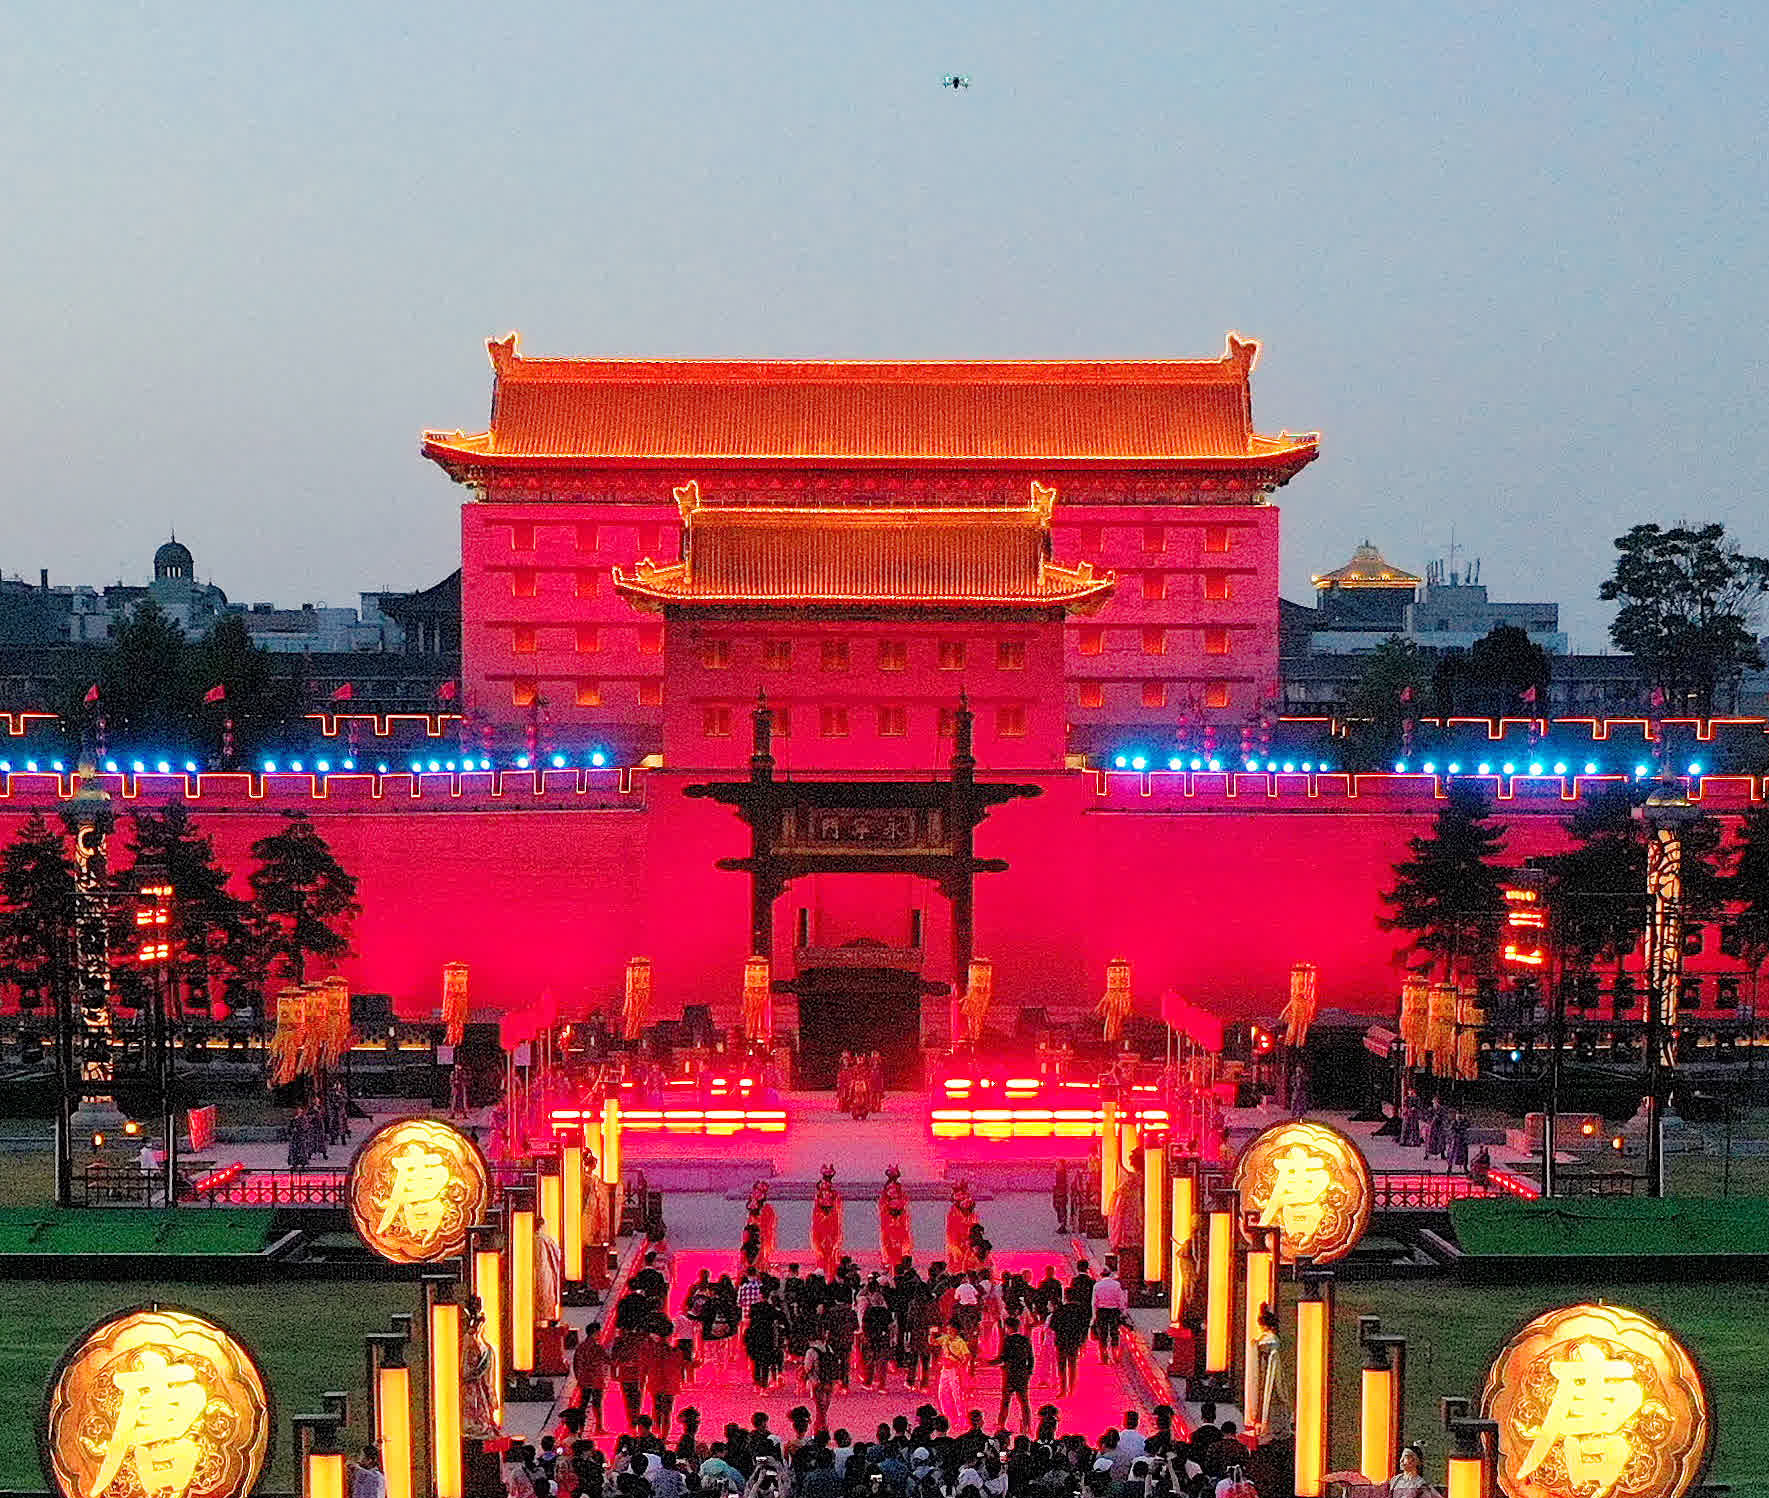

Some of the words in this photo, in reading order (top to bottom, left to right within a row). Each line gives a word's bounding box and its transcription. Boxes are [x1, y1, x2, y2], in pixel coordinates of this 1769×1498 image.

[376, 1144, 450, 1237] 唐
[1258, 1146, 1331, 1236] 唐
[90, 1350, 207, 1498] 唐
[1516, 1342, 1645, 1489] 唐
